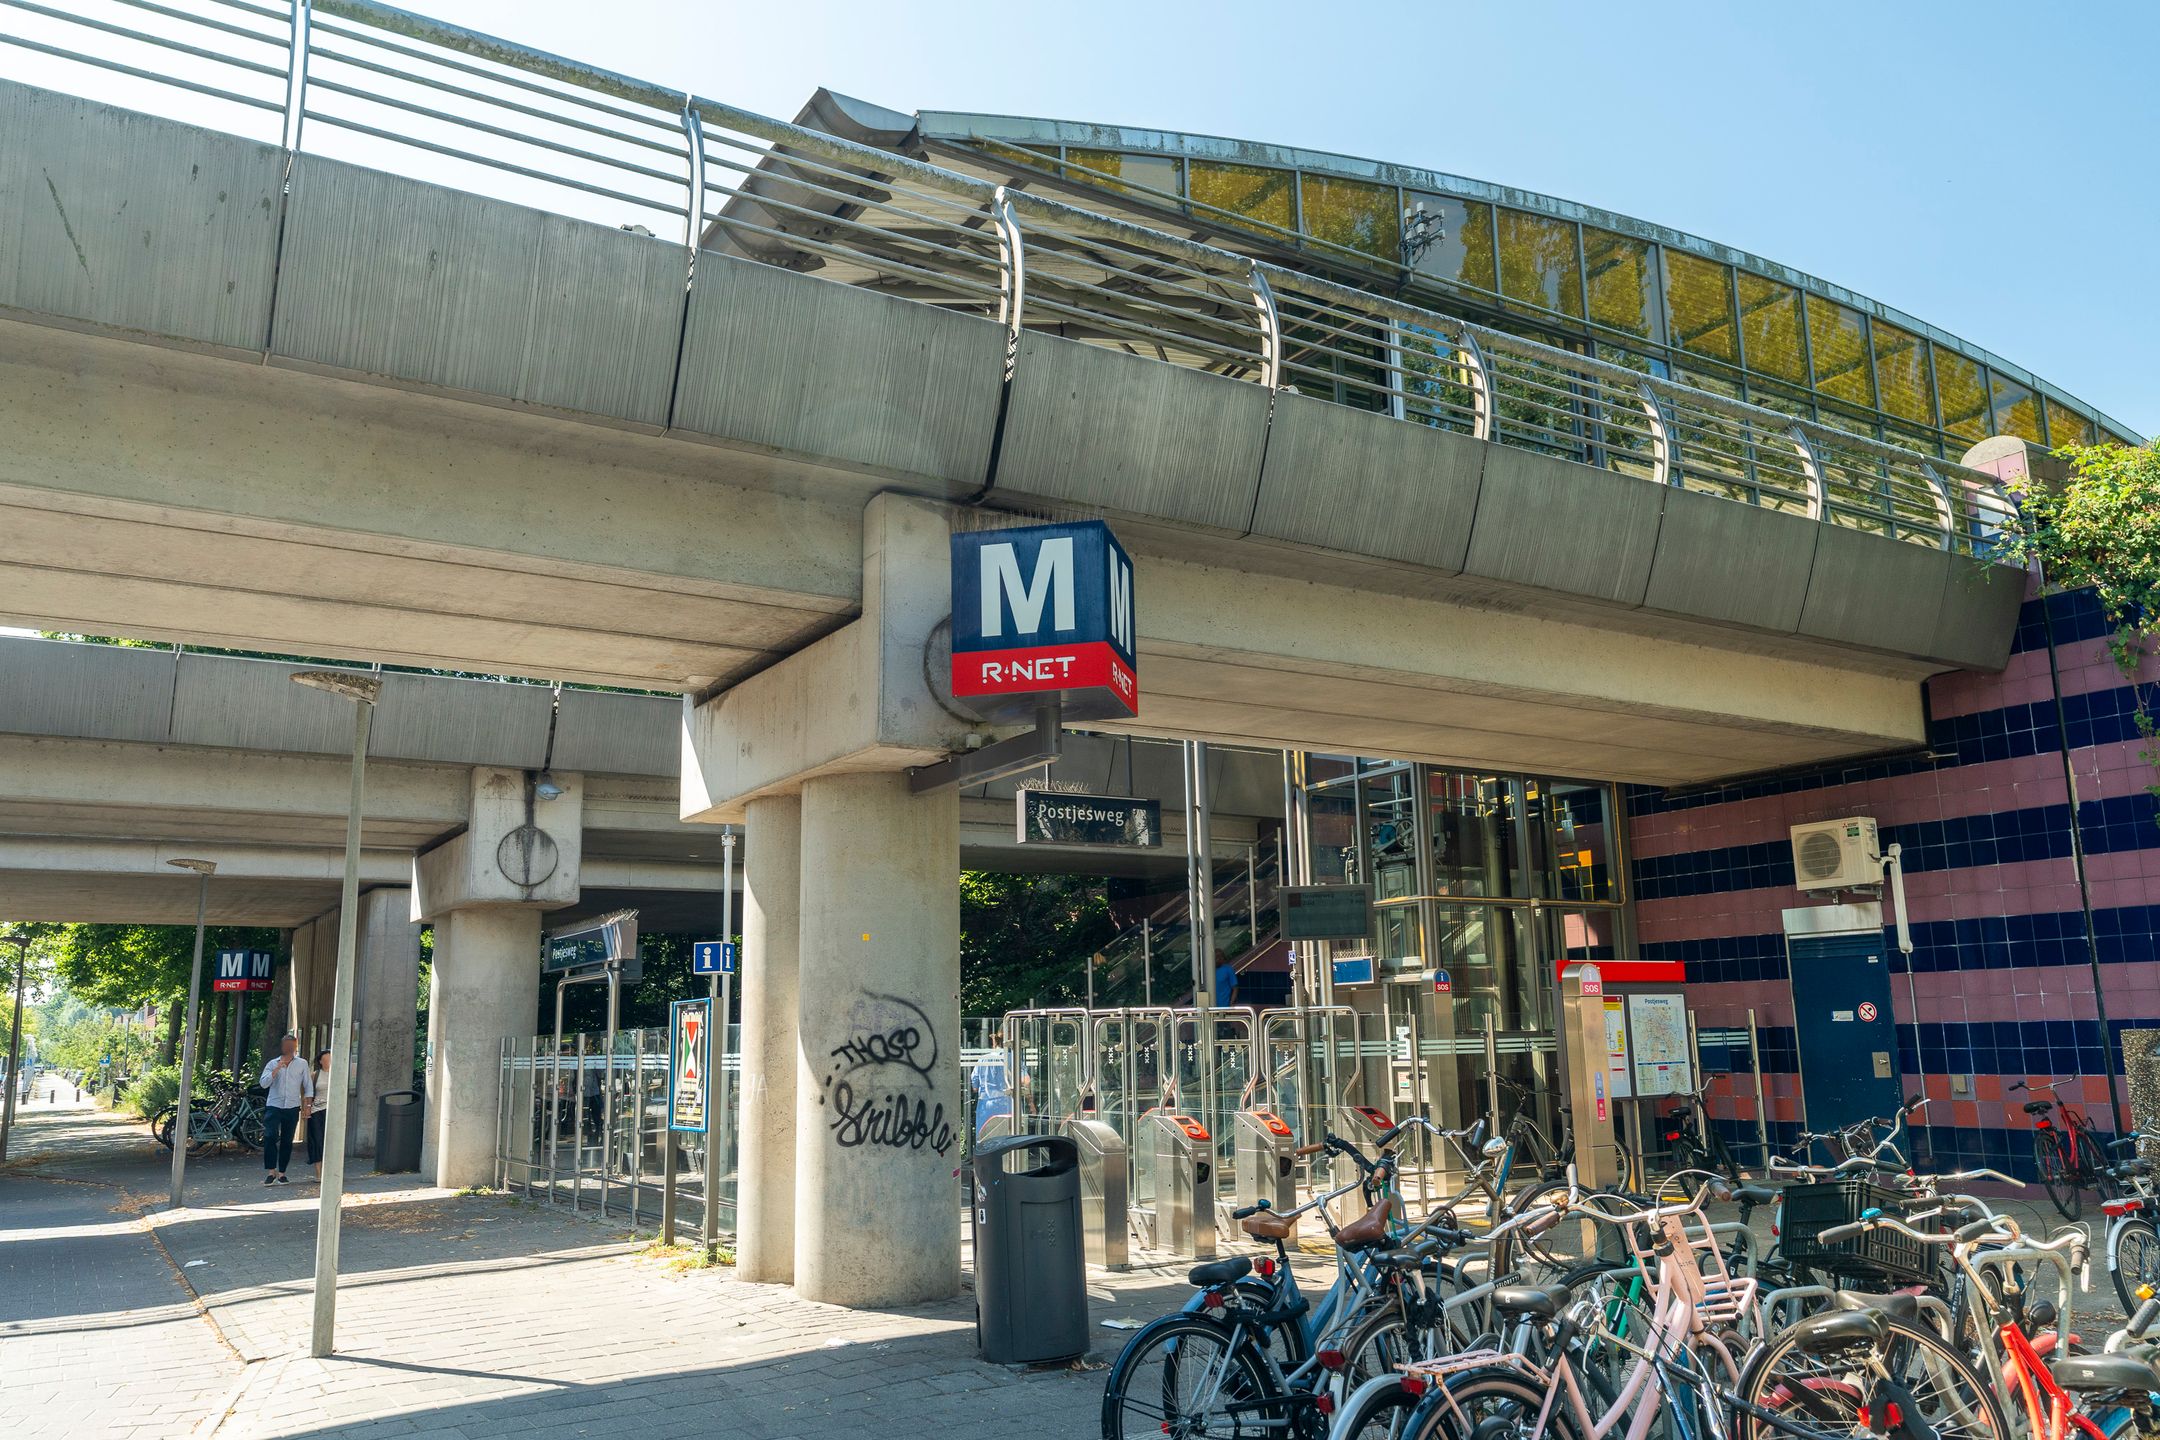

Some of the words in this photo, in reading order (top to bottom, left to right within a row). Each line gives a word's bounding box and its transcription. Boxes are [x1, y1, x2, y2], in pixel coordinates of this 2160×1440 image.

[981, 537, 1076, 638] M
[1109, 544, 1132, 656] M
[1038, 803, 1124, 827] Postjesweg
[221, 953, 243, 977] M
[252, 953, 270, 977] M
[1436, 983, 1449, 991] SOS
[1584, 984, 1599, 993] SOS
